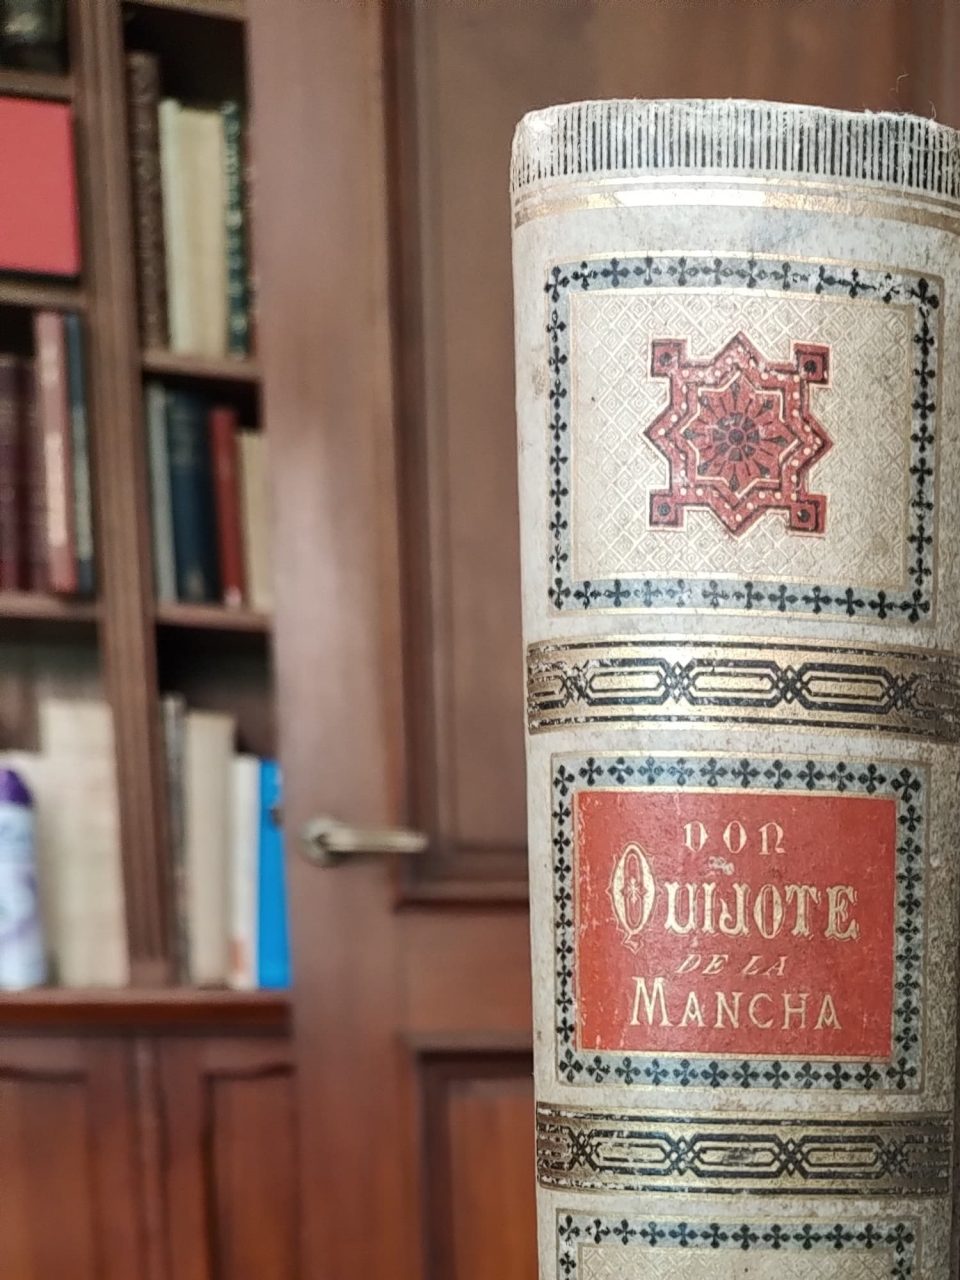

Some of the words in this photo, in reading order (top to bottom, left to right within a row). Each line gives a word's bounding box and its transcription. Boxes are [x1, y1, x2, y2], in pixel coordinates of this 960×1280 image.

[683, 820, 786, 855] DON
[609, 842, 861, 953] QUIJOTE
[674, 954, 729, 975] DE
[740, 954, 788, 977] LA
[628, 976, 843, 1030] MANCHA
